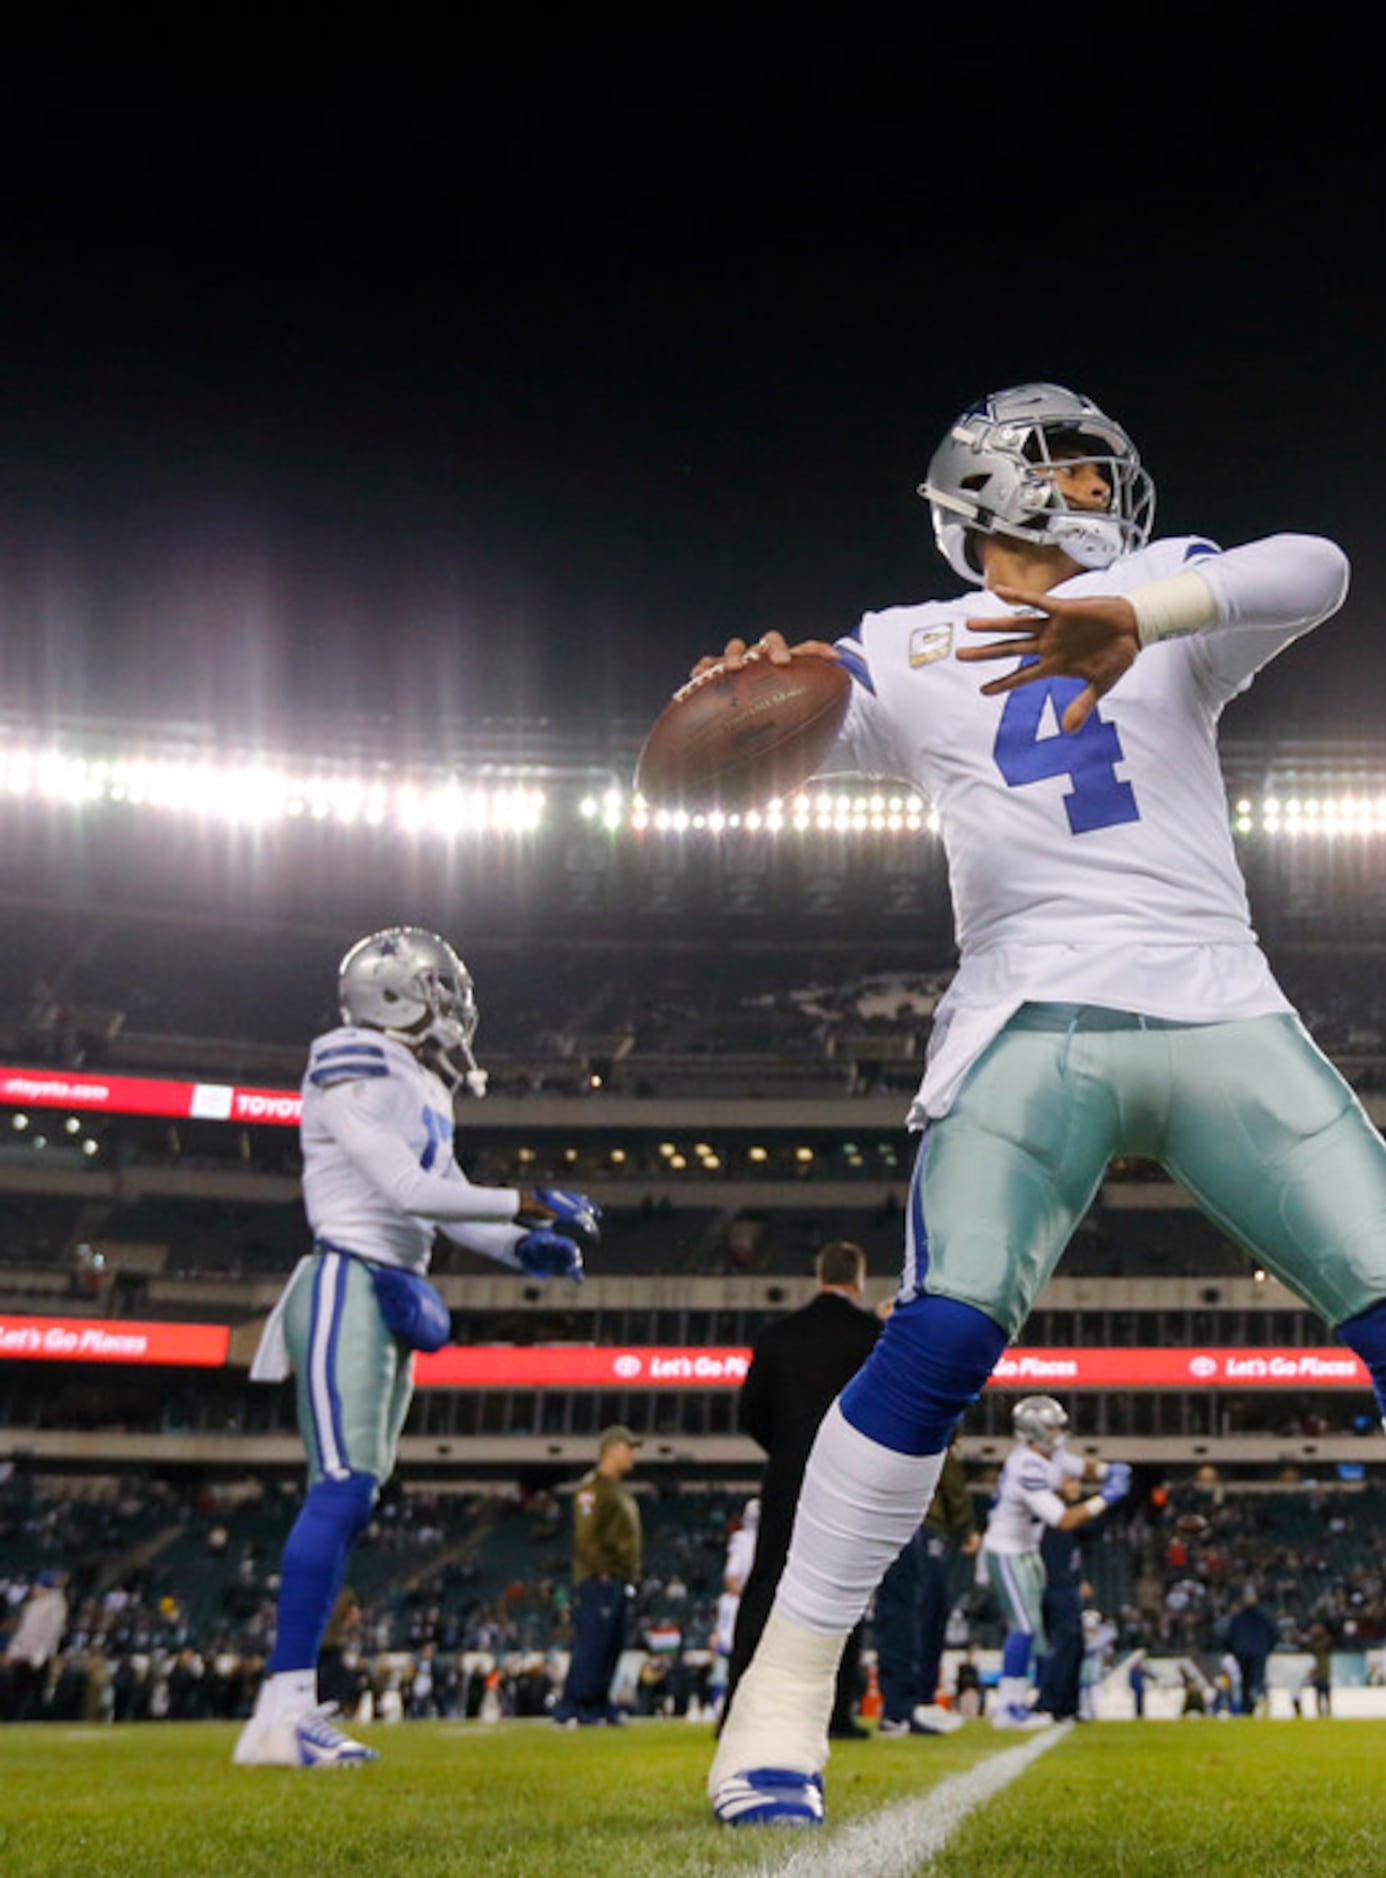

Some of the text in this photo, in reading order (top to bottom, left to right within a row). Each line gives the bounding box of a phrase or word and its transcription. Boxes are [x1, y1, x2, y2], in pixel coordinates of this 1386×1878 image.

[994, 654, 1141, 836] 4
[44, 1328, 78, 1352] Go
[80, 1329, 147, 1354] Places
[649, 1356, 692, 1377] Let's
[694, 1356, 723, 1377] Go
[1019, 1356, 1078, 1377] Places
[1225, 1356, 1357, 1376] Let's Go Places
